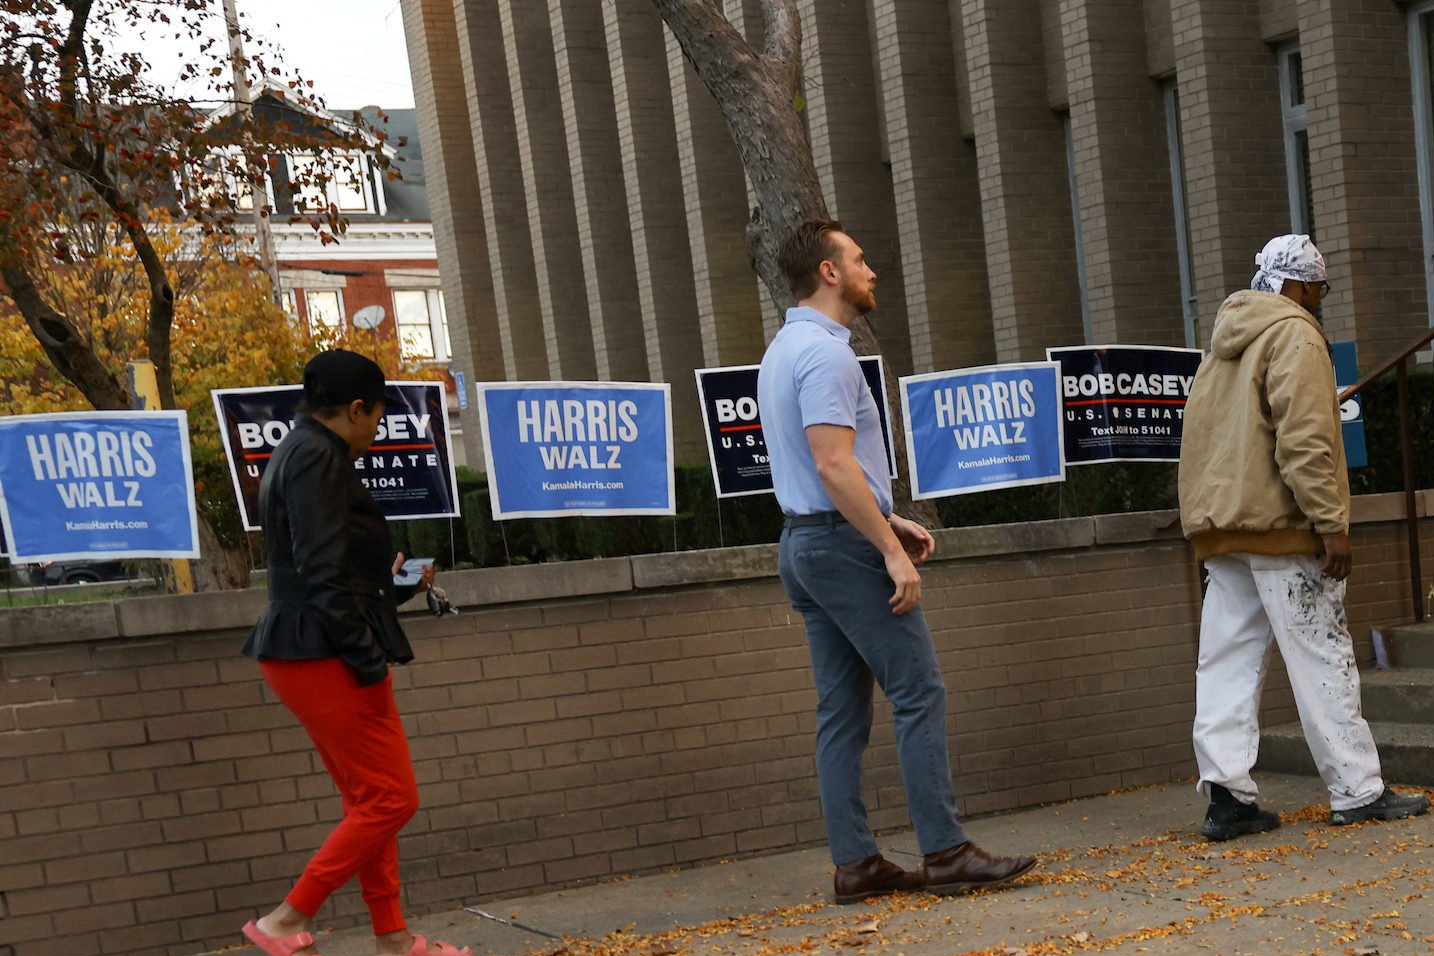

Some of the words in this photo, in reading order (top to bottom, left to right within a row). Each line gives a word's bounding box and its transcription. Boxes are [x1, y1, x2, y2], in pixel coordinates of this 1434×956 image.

[714, 396, 760, 423] BO
[933, 378, 1036, 429] HARRIS
[1124, 407, 1184, 420] SENAT
[237, 419, 295, 449] BO
[374, 413, 431, 441] SEY
[516, 399, 639, 443] HARRIS
[1091, 426, 1114, 436] Text
[1129, 426, 1139, 435] to
[1141, 426, 1171, 435] 51041
[953, 421, 1027, 451] WALZ
[26, 430, 157, 481] HARRIS
[354, 453, 438, 470] ENATE
[539, 445, 622, 470] WALZ
[957, 453, 1031, 470] KamalaHarris.com
[55, 481, 143, 509] WALZ
[361, 476, 405, 489] 51041
[542, 480, 624, 491] KamalaHarris.com
